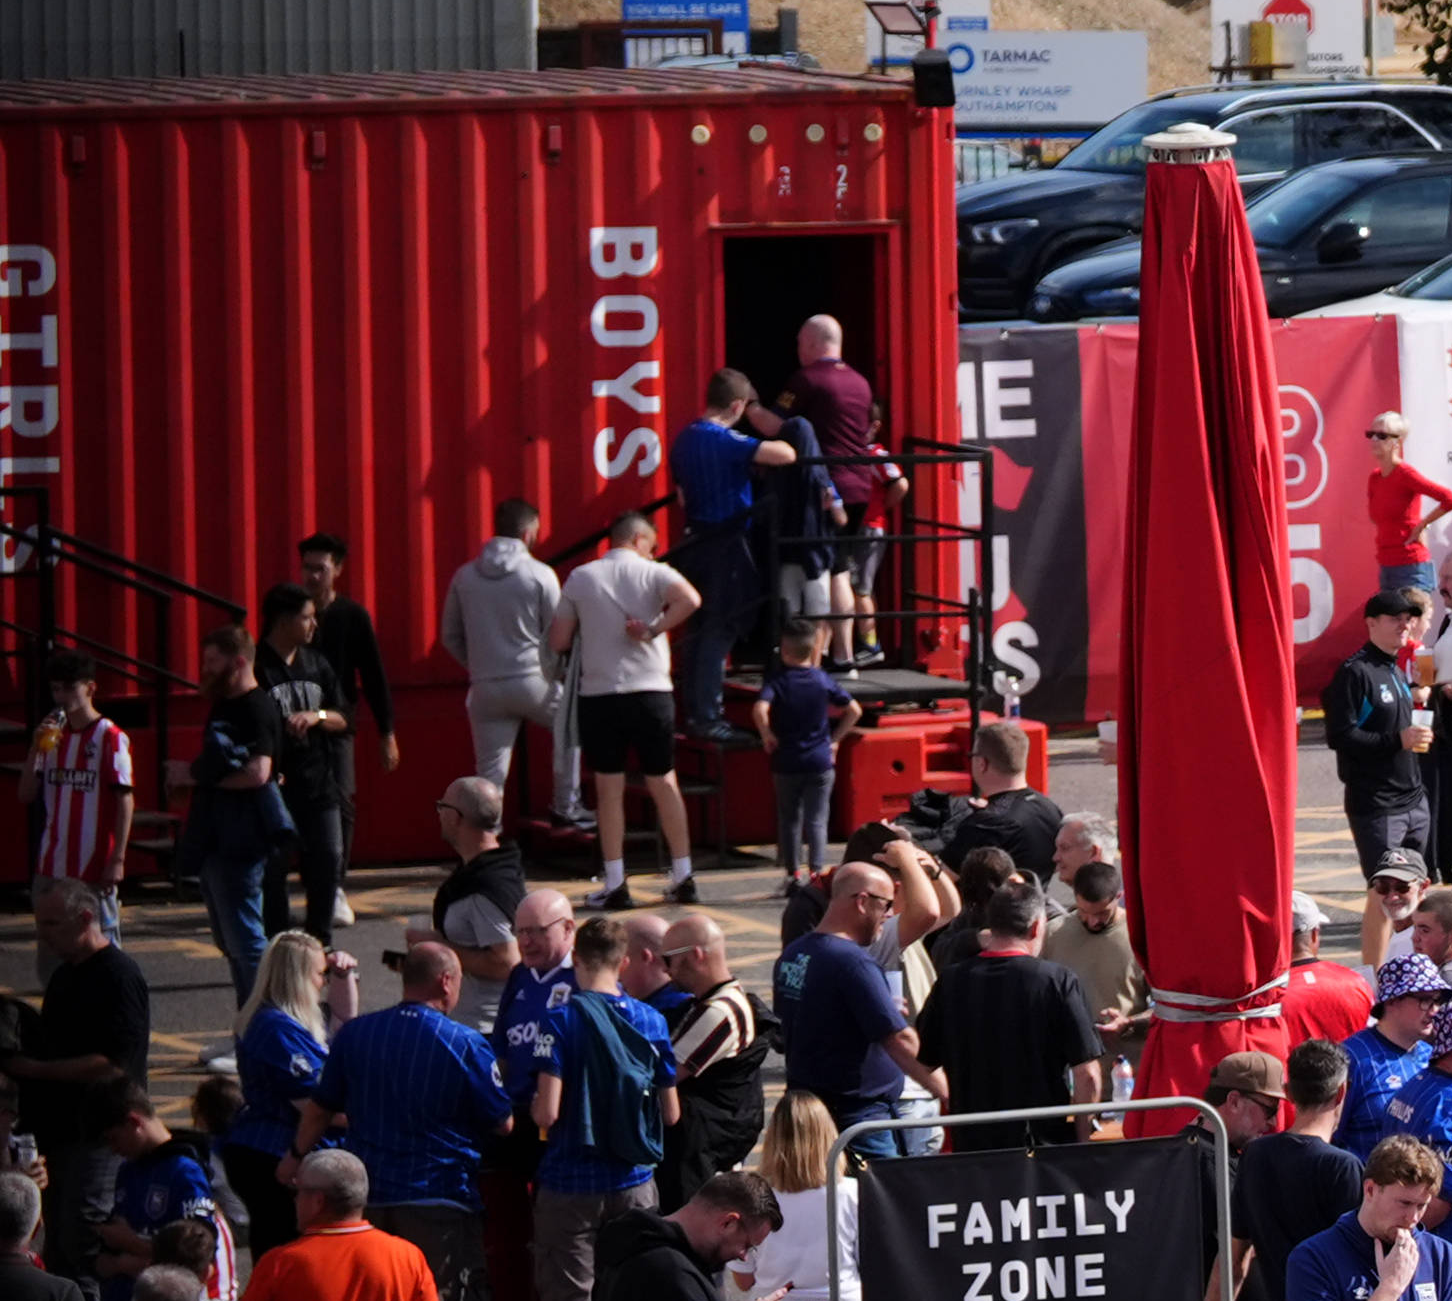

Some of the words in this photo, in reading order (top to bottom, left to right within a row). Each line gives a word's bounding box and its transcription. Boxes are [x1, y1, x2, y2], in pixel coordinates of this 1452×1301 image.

[982, 49, 1051, 64] TARMAC
[1304, 52, 1344, 62] ISITORS
[954, 85, 1012, 97] URNLEY
[954, 99, 1058, 112] OUTHAMPTON
[588, 225, 664, 480] BOYS
[927, 1189, 1136, 1249] FAMILY
